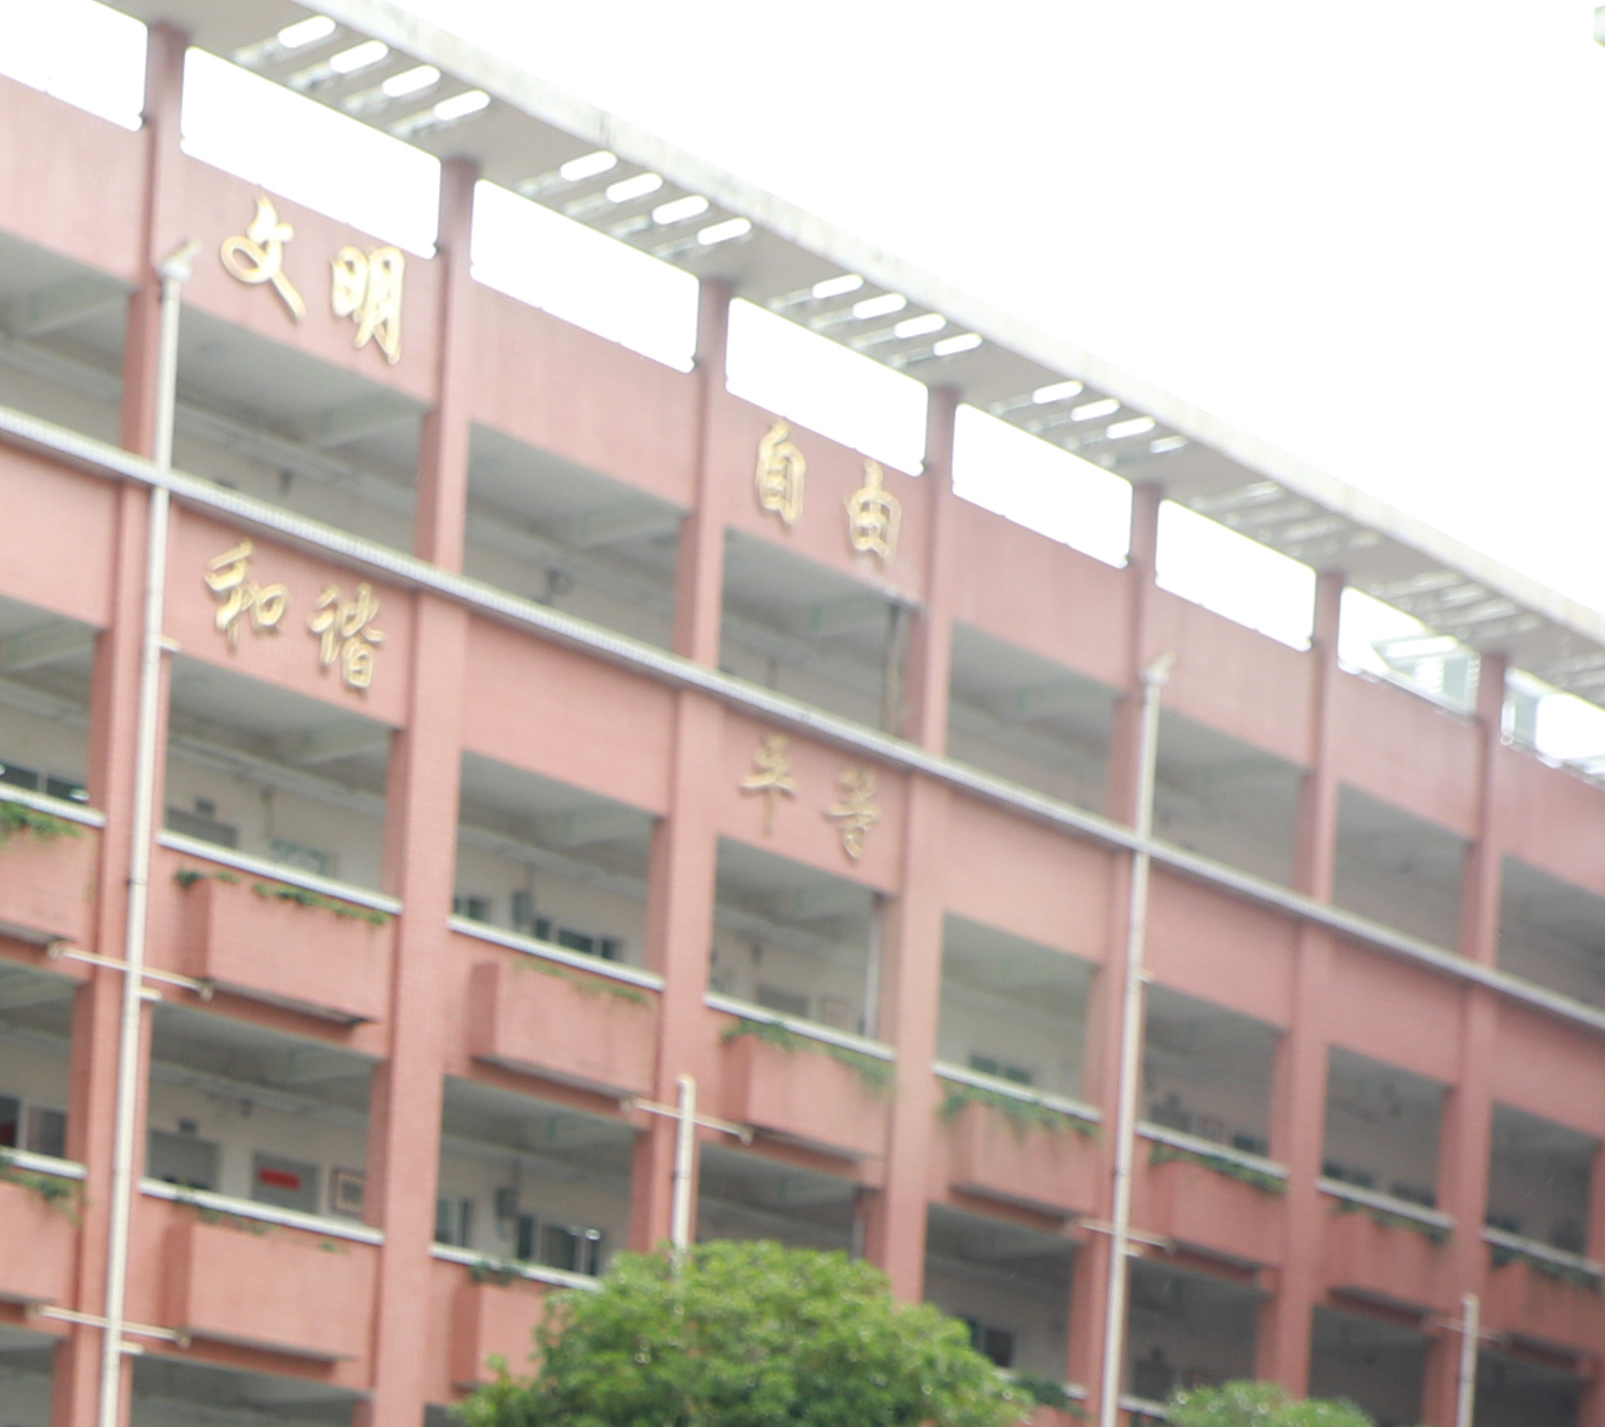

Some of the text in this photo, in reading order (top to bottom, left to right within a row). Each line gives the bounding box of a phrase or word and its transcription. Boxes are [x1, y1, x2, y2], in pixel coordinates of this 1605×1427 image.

[221, 196, 405, 365] 文明
[754, 418, 904, 564] 自由
[204, 540, 386, 693] 和谐
[738, 732, 882, 862] 平等
